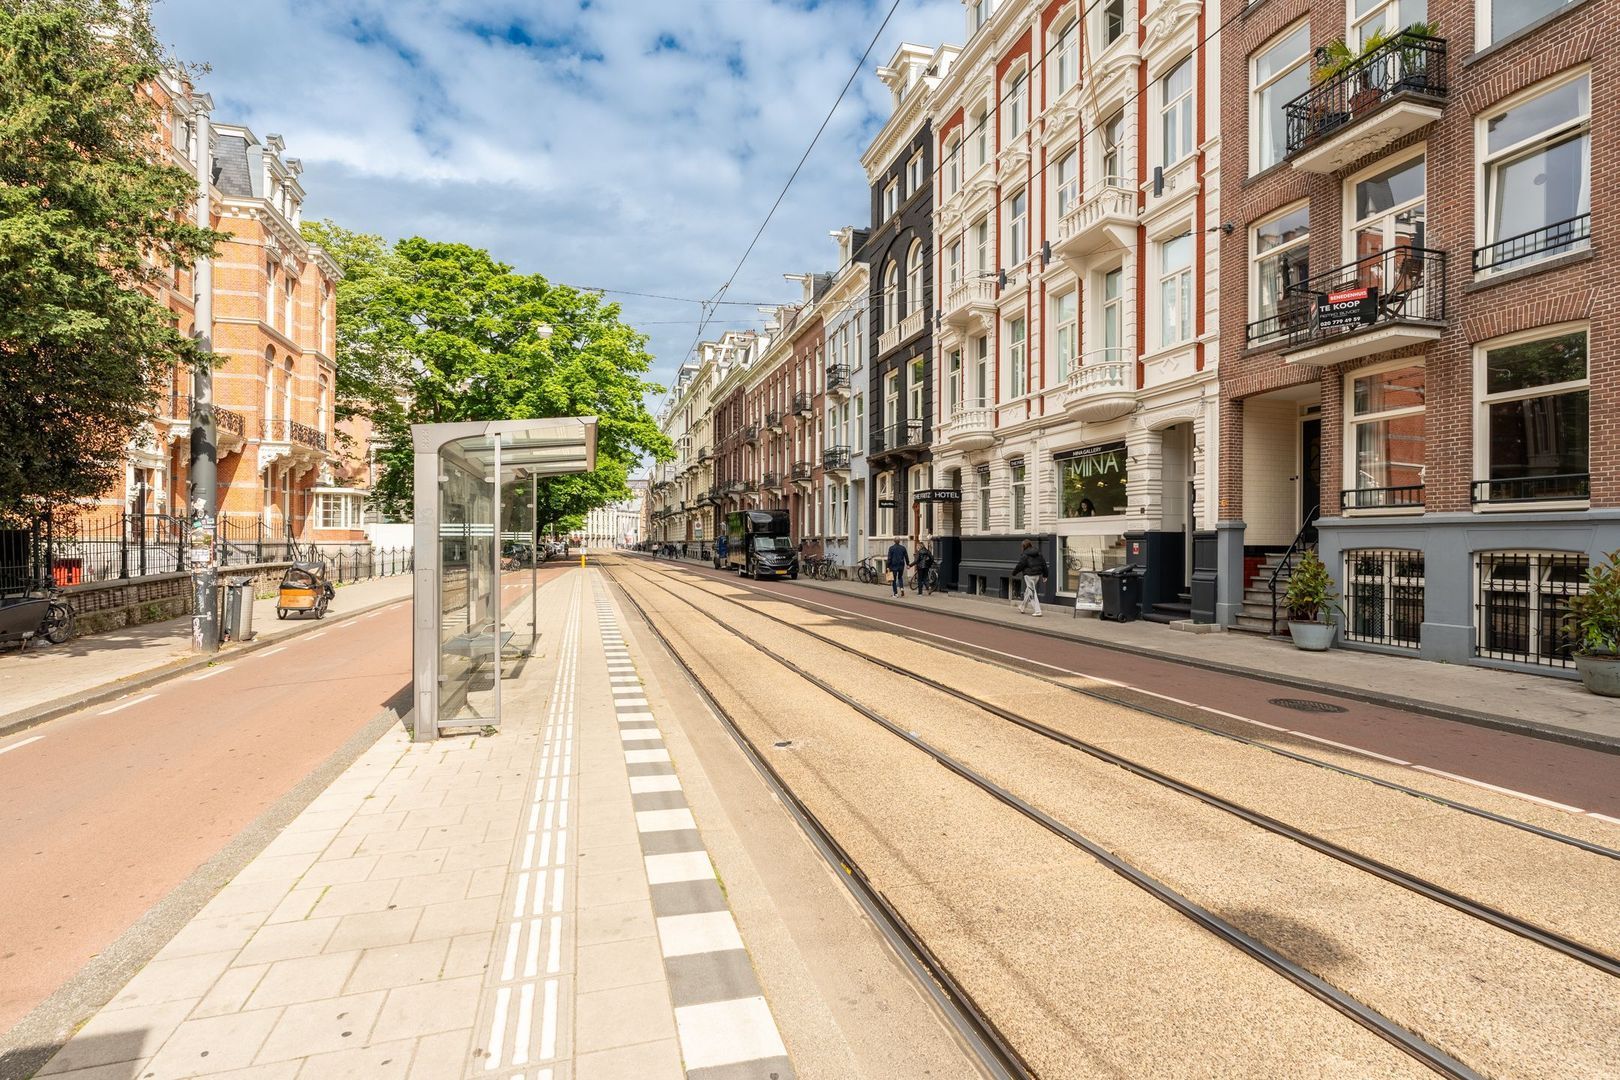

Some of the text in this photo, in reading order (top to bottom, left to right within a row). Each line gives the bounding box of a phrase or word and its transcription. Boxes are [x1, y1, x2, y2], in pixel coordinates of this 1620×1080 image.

[1330, 291, 1367, 300] BENEDENHUIS
[1333, 300, 1360, 310] KOOP
[1071, 452, 1119, 478] MINA
